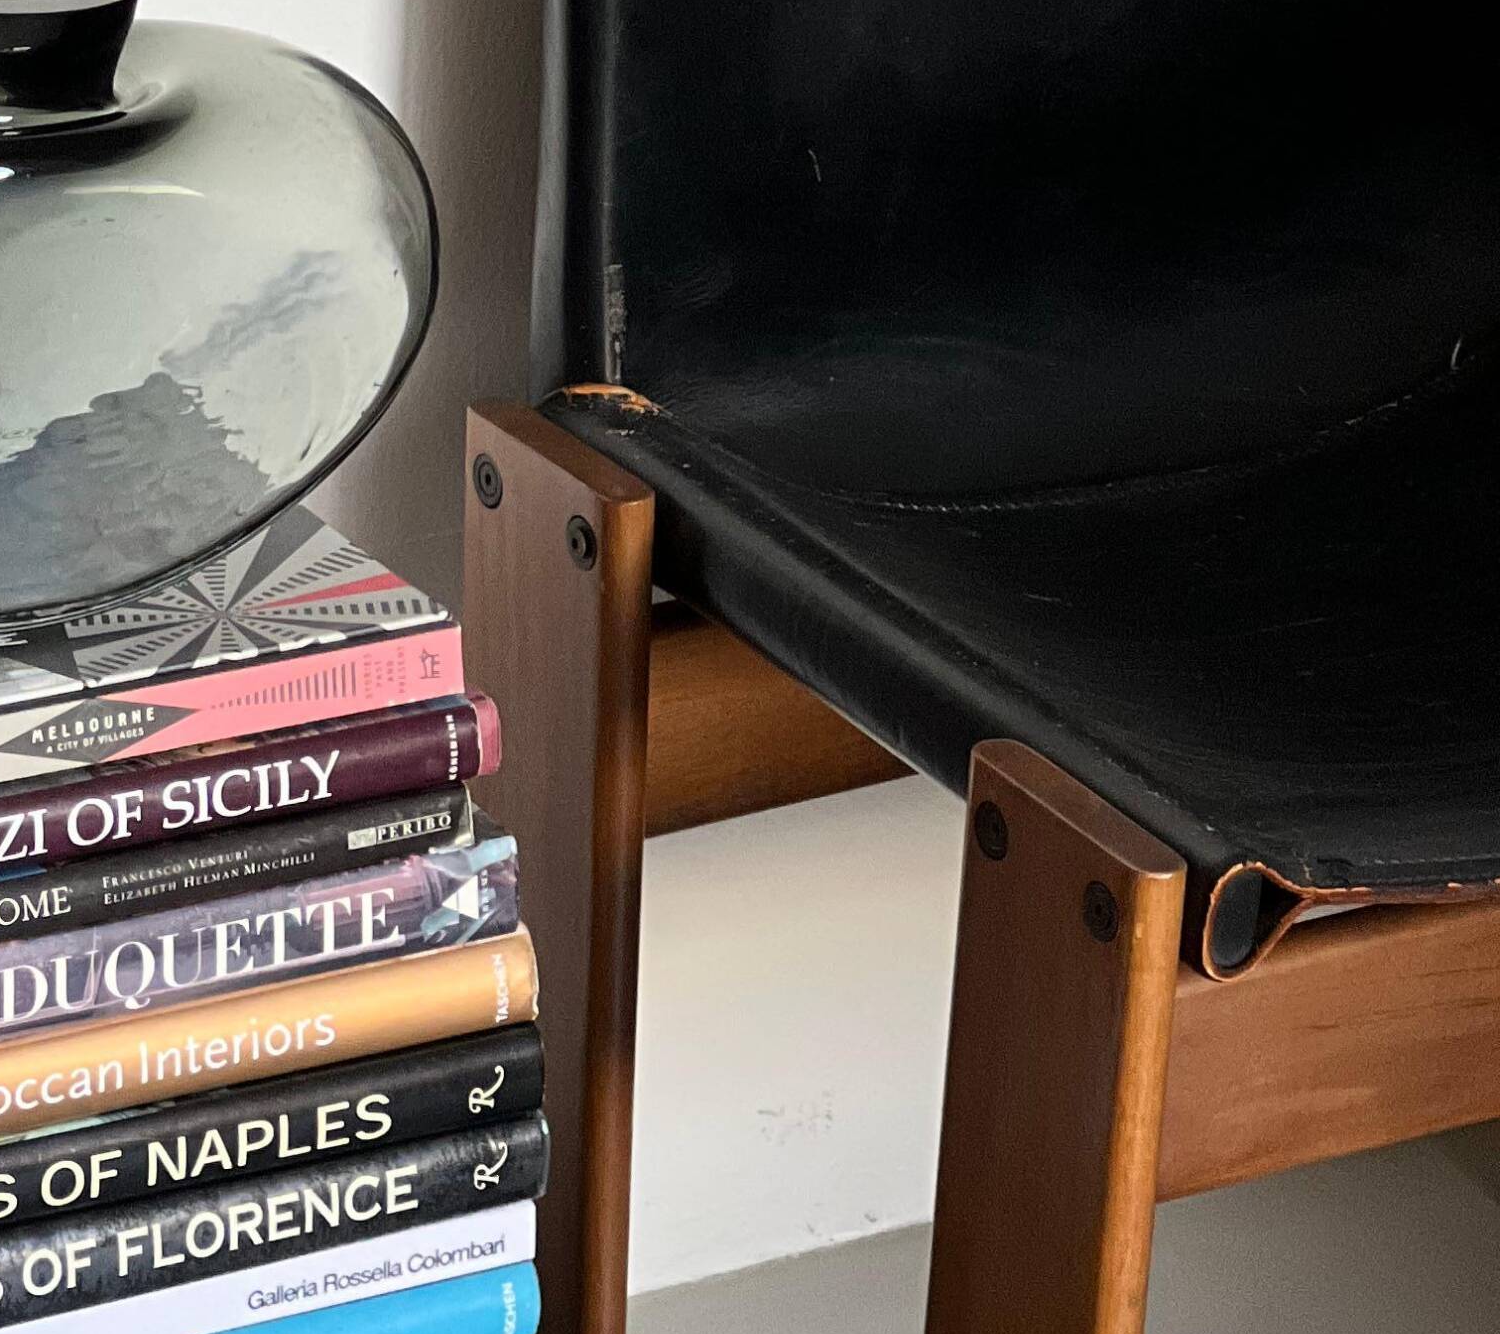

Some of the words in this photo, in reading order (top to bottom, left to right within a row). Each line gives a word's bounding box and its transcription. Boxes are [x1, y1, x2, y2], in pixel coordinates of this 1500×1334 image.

[31, 707, 156, 744] MELBOURNE
[46, 743, 54, 754] A
[57, 739, 79, 752] CITY
[82, 736, 96, 748] OF
[98, 726, 145, 745] VILLAGES
[66, 789, 145, 848] OF
[161, 749, 341, 831] SICILY
[376, 814, 452, 842] PERIBO
[102, 864, 183, 890] FRANCESCO
[187, 850, 248, 870] VENTURI
[103, 881, 177, 906] ELIZABETH
[183, 869, 240, 889] HELMAN
[243, 852, 316, 876] MINCHILLI
[491, 953, 509, 1023] TASCHEN
[139, 1012, 337, 1085] Interiors
[468, 1065, 504, 1114] R
[40, 1149, 122, 1207] OF
[147, 1094, 393, 1187] NAPLES
[473, 1141, 508, 1191] R
[22, 1238, 98, 1297] OF
[116, 1165, 420, 1277] FLORENCE
[247, 1278, 319, 1311] Galleria
[323, 1259, 403, 1291] Rossella
[406, 1233, 507, 1274] Colombari
